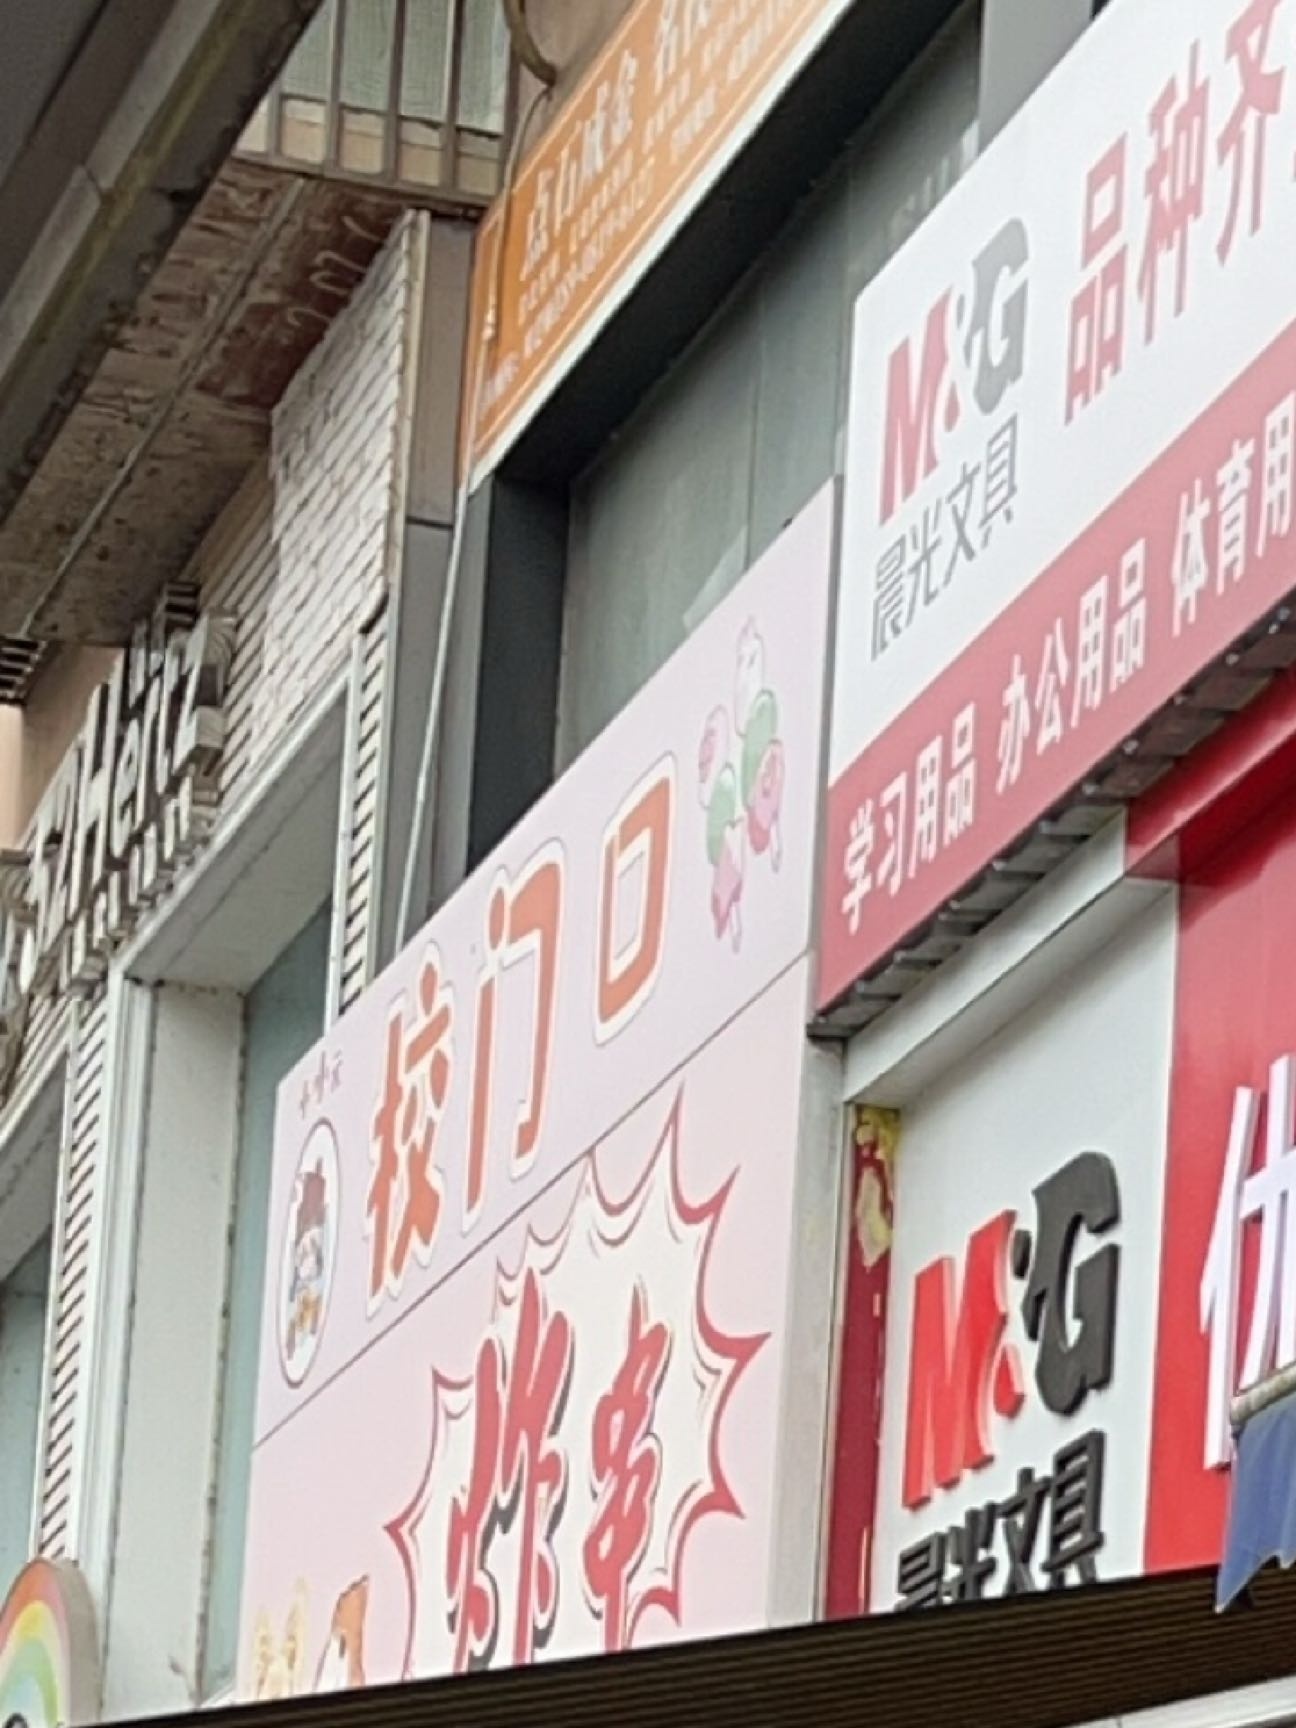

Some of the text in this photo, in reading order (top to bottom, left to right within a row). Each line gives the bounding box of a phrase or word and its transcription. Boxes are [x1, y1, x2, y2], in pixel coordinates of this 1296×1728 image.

[871, 412, 1019, 662] 晨光文具
[880, 217, 1030, 528] M&G
[842, 701, 977, 935] 学习用品
[995, 537, 1148, 795] 办公用品
[366, 765, 676, 1306] 校门口
[445, 1266, 671, 1674] 炸串
[903, 1151, 1122, 1511] M&G
